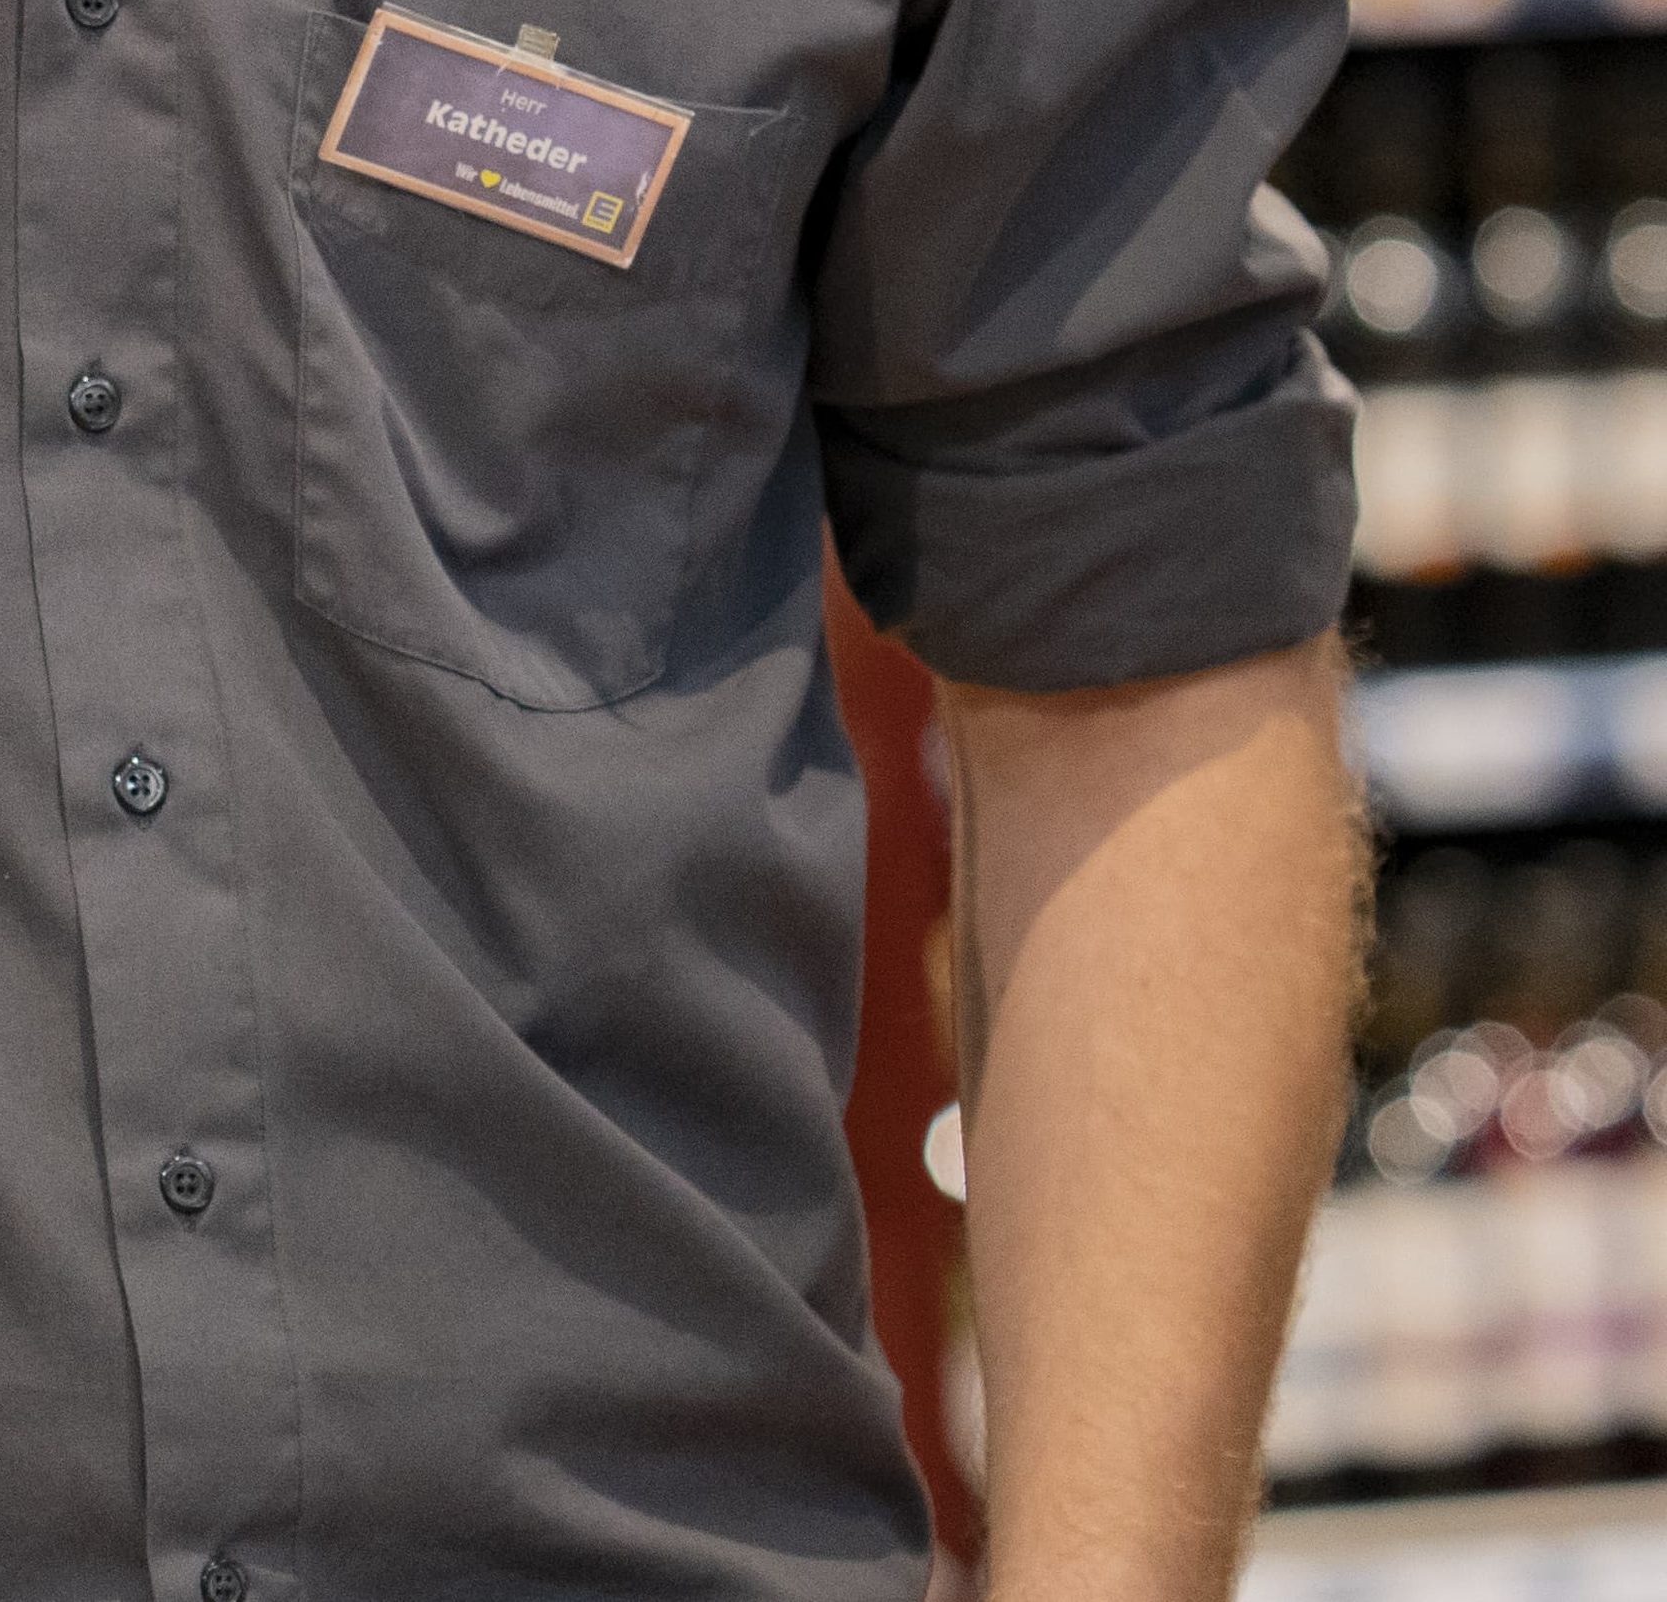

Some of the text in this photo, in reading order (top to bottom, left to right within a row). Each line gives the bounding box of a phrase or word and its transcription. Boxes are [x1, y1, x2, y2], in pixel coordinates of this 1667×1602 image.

[500, 88, 548, 115] Herr
[425, 99, 589, 174] Katheder
[455, 162, 479, 182] Wir
